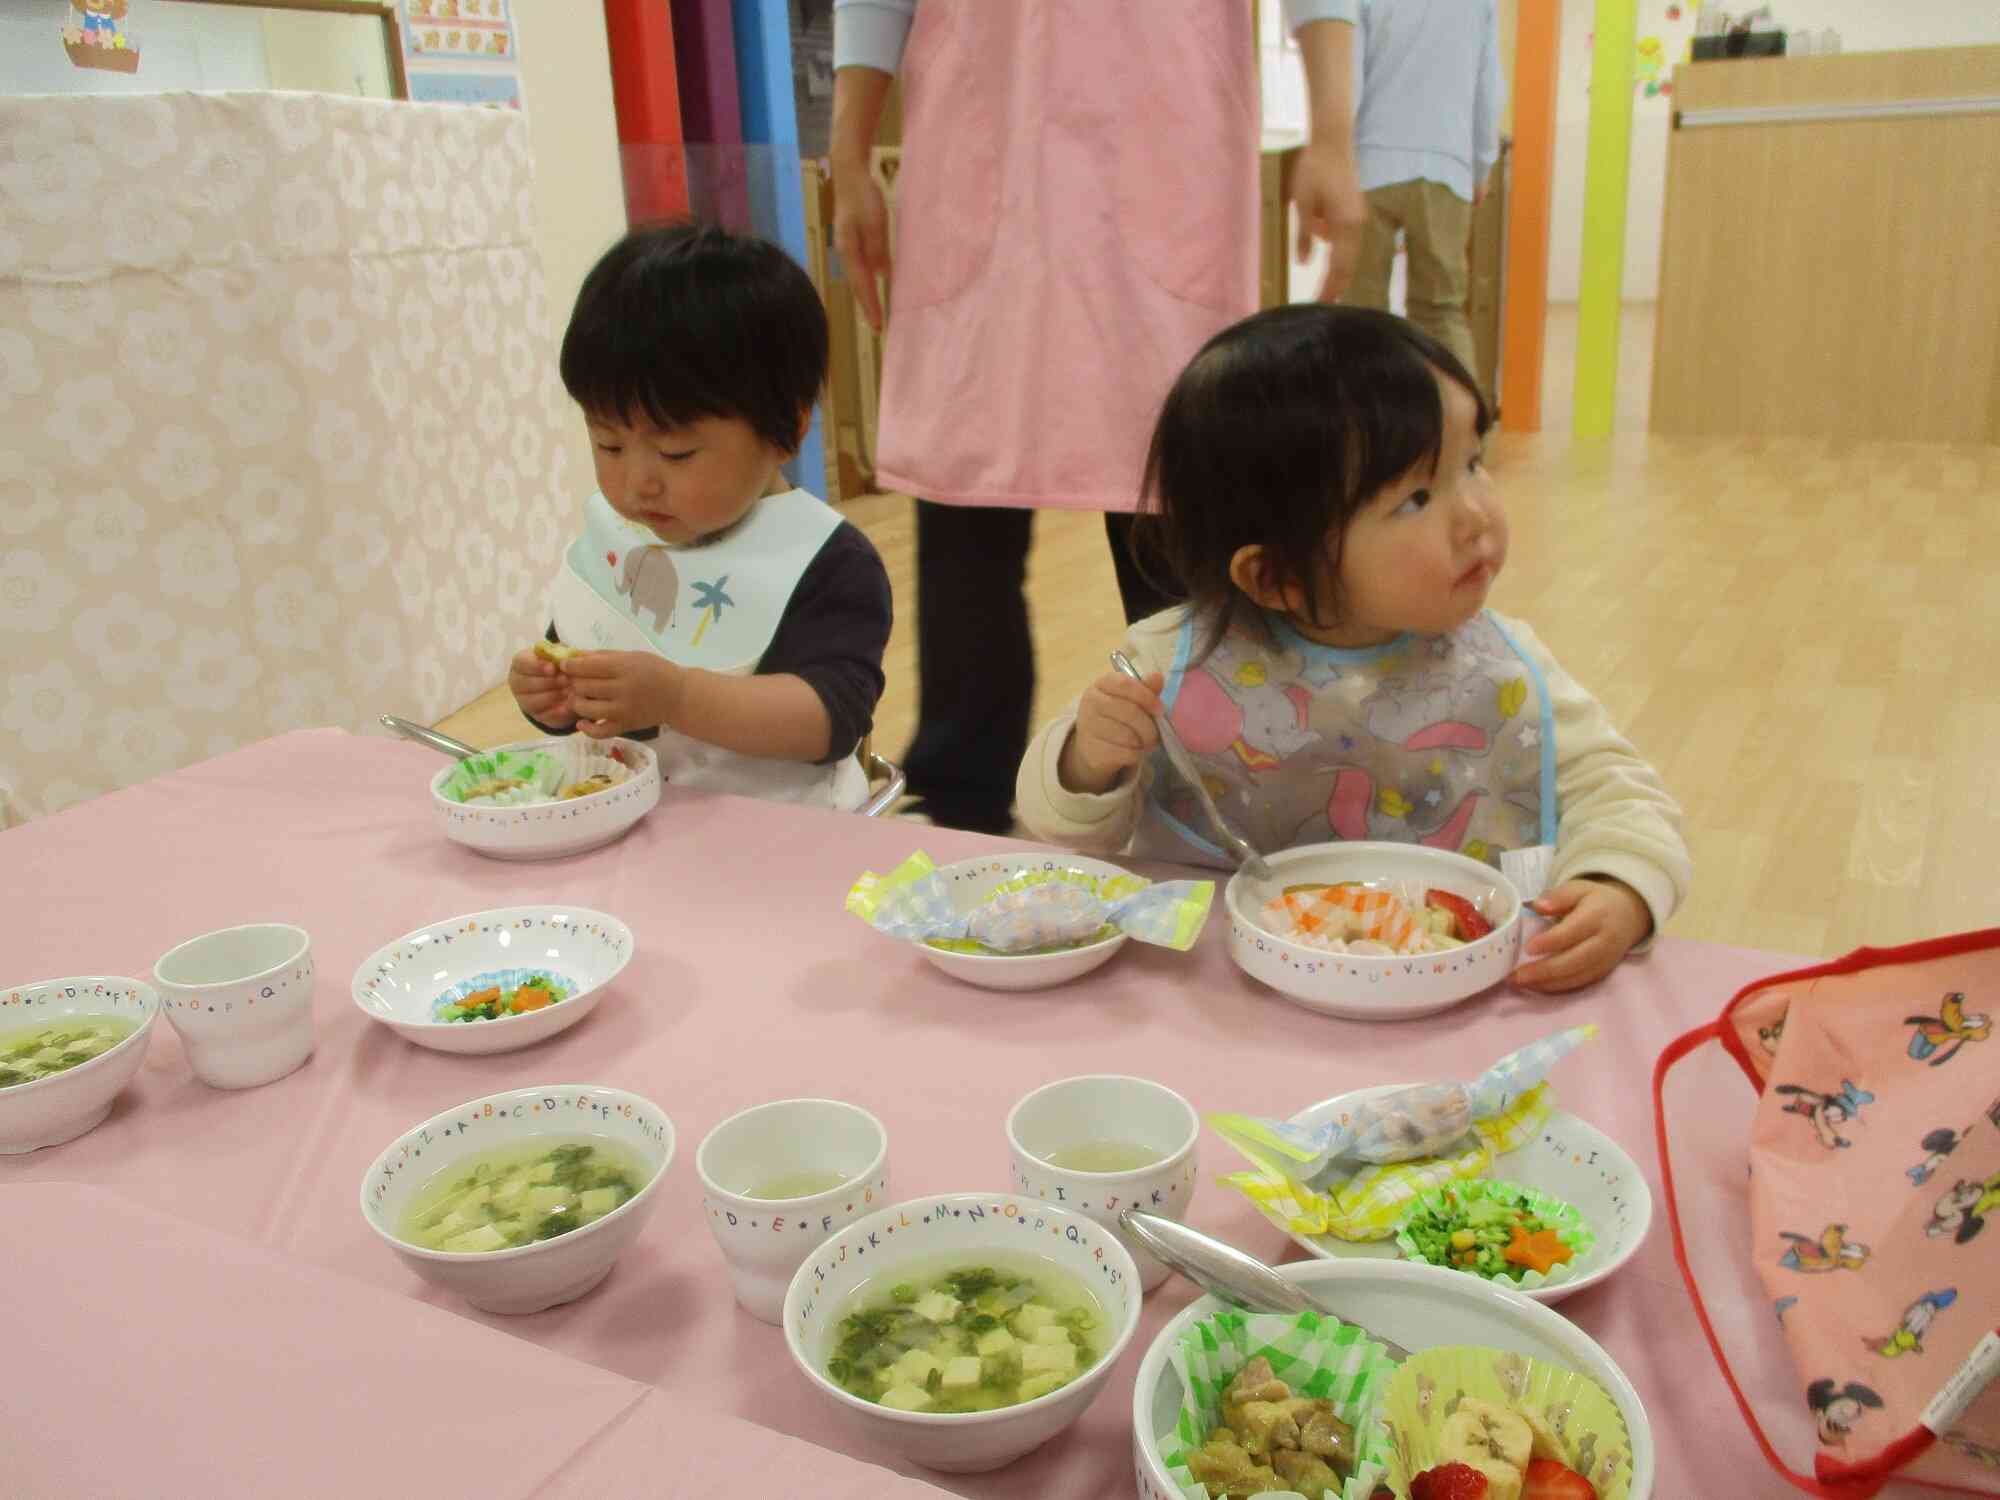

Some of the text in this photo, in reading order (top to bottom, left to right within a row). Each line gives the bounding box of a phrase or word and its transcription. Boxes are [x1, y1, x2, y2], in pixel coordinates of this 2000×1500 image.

[522, 919, 532, 928] D
[1403, 962, 1412, 974] V
[64, 987, 76, 999] D
[260, 986, 275, 999] Q
[383, 1165, 394, 1181] X
[419, 1130, 433, 1145] Z
[457, 1121, 470, 1135] A
[484, 1103, 493, 1118] B
[512, 1105, 523, 1118] C
[543, 1098, 556, 1111] D
[576, 1095, 588, 1110] E
[602, 1106, 608, 1120] F
[1588, 1151, 1599, 1165] I
[1056, 1187, 1162, 1211] I J K
[726, 1211, 738, 1226] D
[772, 1216, 785, 1233] E
[822, 1215, 832, 1231] F
[814, 1266, 825, 1281] I
[839, 1245, 847, 1262] J
[868, 1232, 881, 1248] K
[899, 1211, 911, 1227] L
[935, 1203, 951, 1219] M
[968, 1204, 985, 1222] N
[1004, 1204, 1018, 1218] O
[1034, 1217, 1045, 1231] P
[1066, 1225, 1079, 1244] Q
[1110, 1269, 1117, 1285] S
